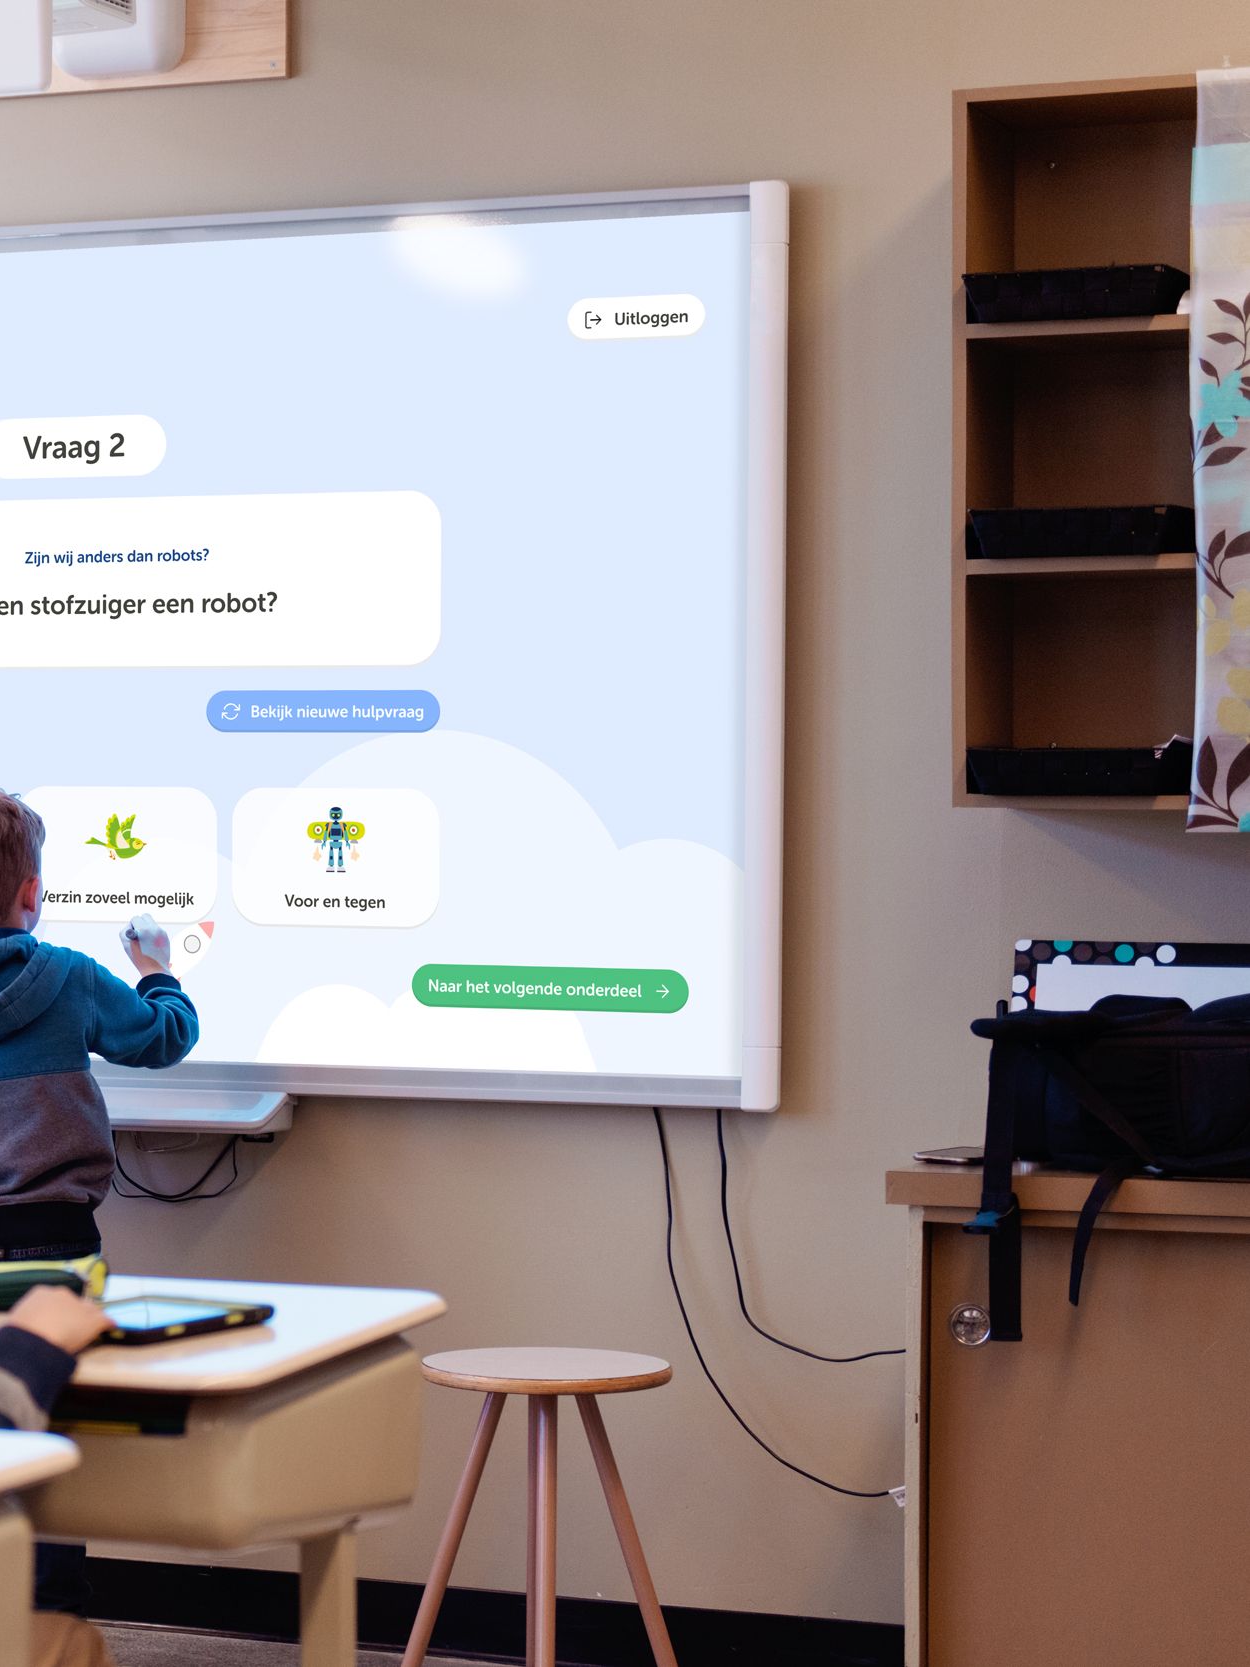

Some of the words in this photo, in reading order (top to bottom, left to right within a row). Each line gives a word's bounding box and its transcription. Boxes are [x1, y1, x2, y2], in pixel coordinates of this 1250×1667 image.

[614, 311, 689, 328] Uitloggen
[22, 435, 101, 465] Vraag
[109, 432, 126, 458] 2
[24, 550, 50, 568] Zijn
[53, 550, 74, 567] wij
[76, 548, 124, 564] anders
[126, 548, 154, 564] dan
[157, 546, 210, 563] robots?
[30, 593, 147, 621] stofzuiger
[151, 597, 195, 615] een
[201, 590, 278, 614] robot?
[250, 704, 293, 722] Bekijk
[296, 704, 349, 719] nieuwe
[352, 704, 424, 722] hulpvraag
[85, 891, 131, 905] zoveel
[134, 892, 195, 909] mogelijk
[284, 893, 320, 908] Voor
[322, 897, 341, 909] en
[344, 895, 386, 912] tegen
[427, 978, 463, 994] Naar
[465, 979, 490, 994] het
[493, 980, 563, 998] volgende
[565, 982, 642, 998] onderdeel
